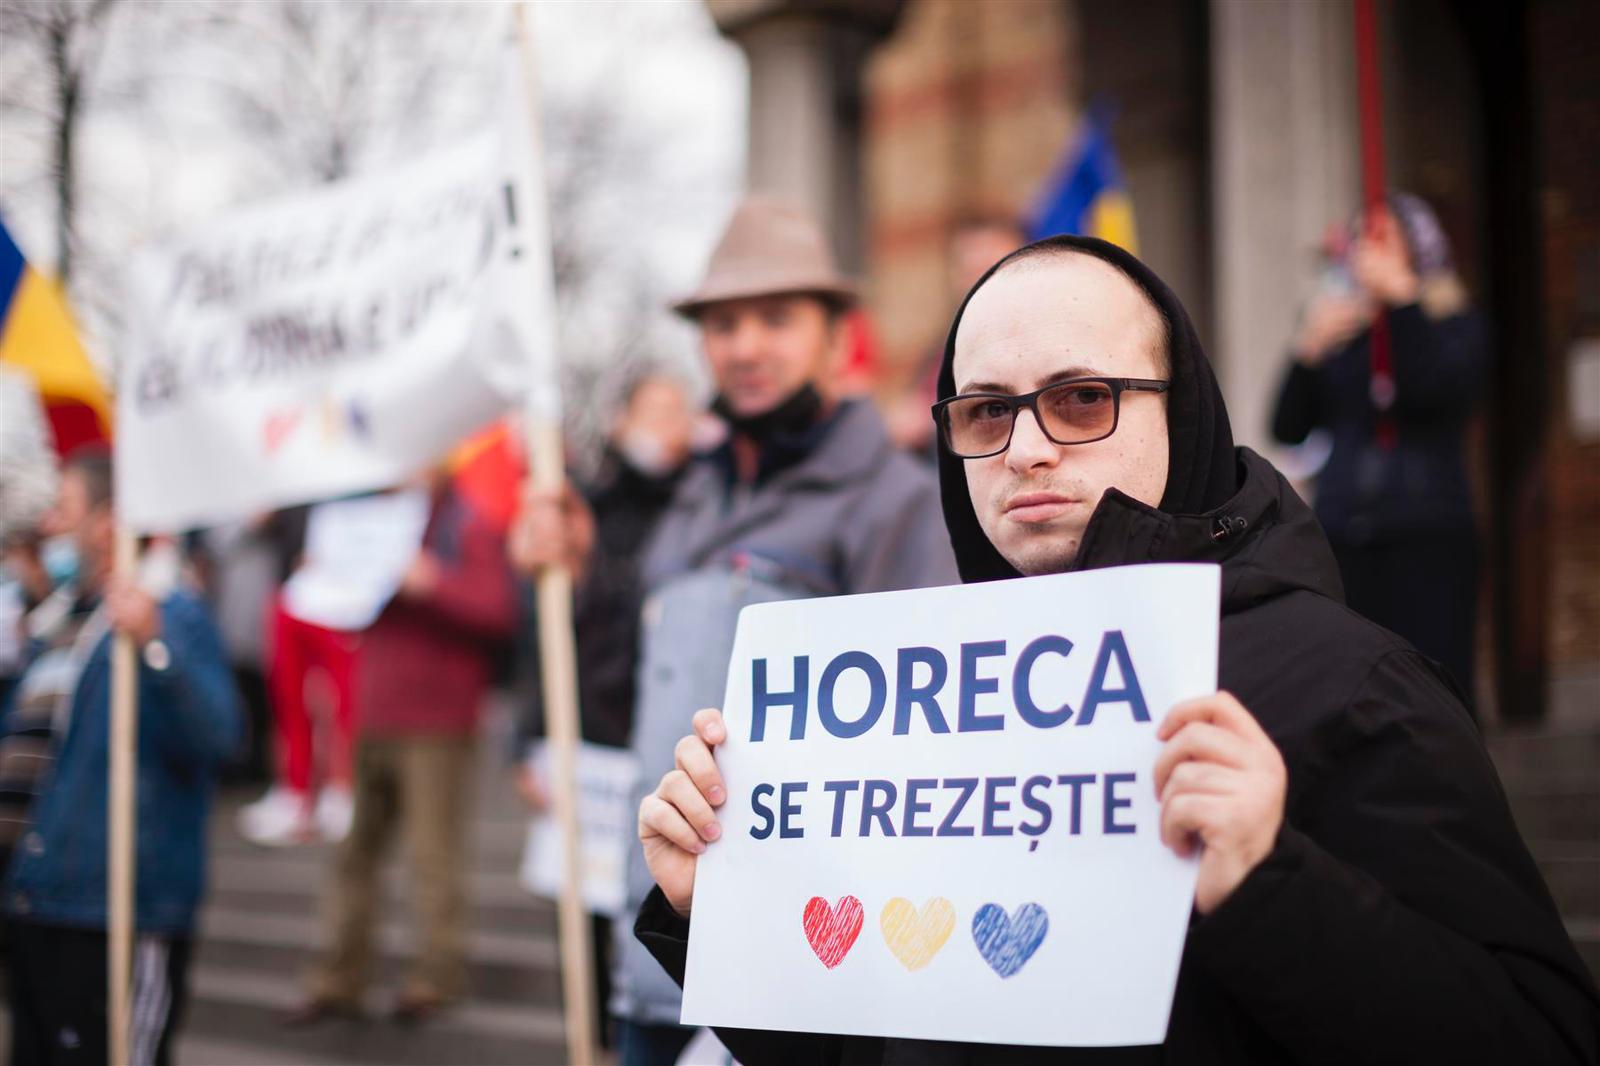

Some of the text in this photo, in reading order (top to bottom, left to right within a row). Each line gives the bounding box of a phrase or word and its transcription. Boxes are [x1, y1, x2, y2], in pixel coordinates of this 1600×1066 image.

[749, 630, 1152, 742] HORECA
[749, 772, 1138, 854] SE TREZEȘTE
